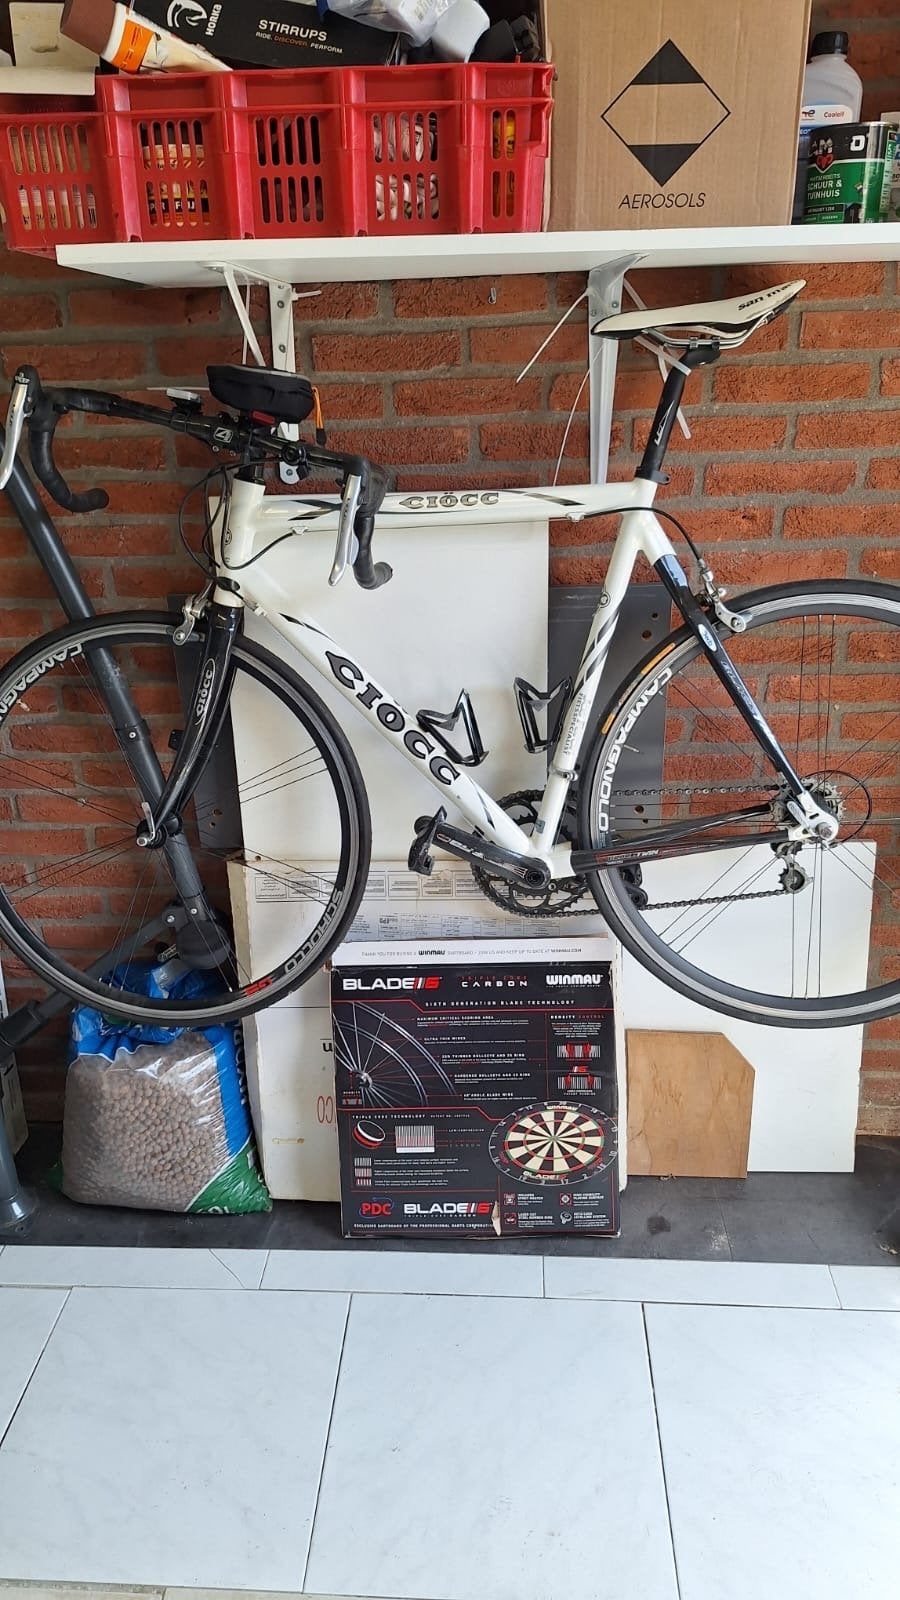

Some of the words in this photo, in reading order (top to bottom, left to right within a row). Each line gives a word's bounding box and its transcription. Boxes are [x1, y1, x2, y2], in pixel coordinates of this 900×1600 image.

[258, 19, 328, 42] STIRRUPS
[310, 42, 343, 54] PERFORM
[835, 179, 843, 188] &
[618, 191, 707, 210] AEROSOLS
[738, 296, 765, 311] san
[325, 650, 461, 786] CIOCC
[597, 666, 673, 832] CAMPAGNOLO
[284, 888, 343, 975] SCIROCCO
[461, 980, 528, 988] CARBON
[545, 974, 603, 986] WINMAU
[361, 1202, 392, 1216] PDC
